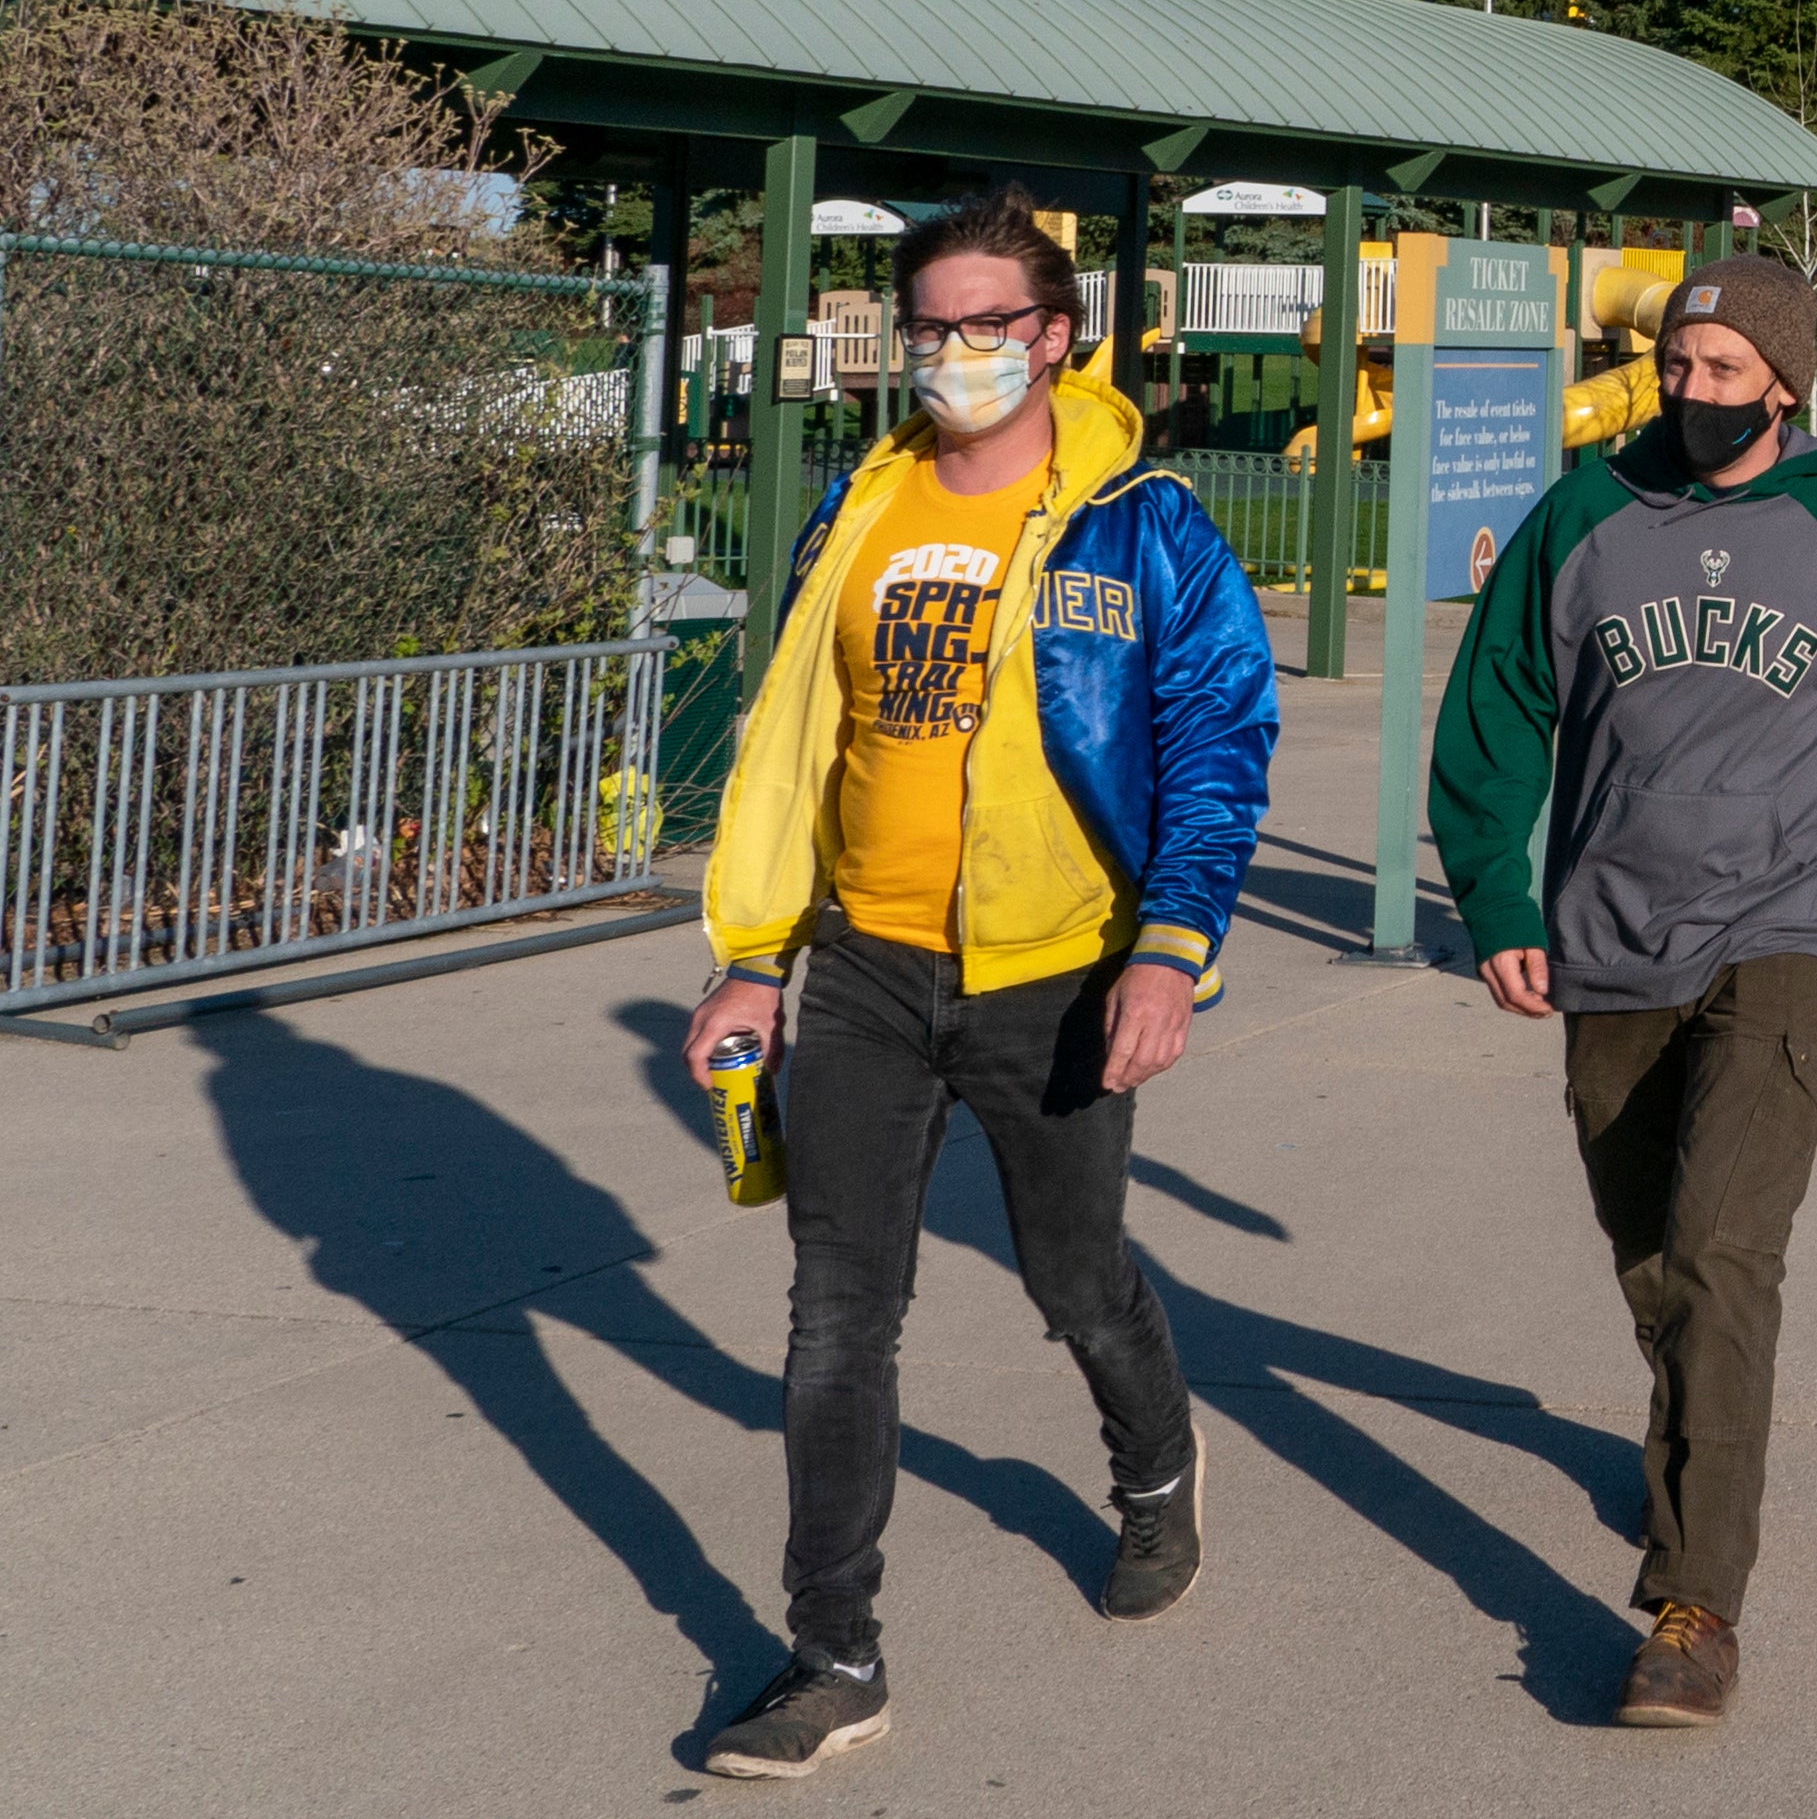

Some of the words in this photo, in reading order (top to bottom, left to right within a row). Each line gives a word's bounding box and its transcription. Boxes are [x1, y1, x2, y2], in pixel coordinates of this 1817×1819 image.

[1234, 201, 1274, 210] Children's
[1276, 202, 1303, 210] Health
[1235, 192, 1262, 201] Aurora
[816, 223, 854, 232] Children's
[856, 223, 884, 232] Health
[817, 214, 843, 222] Aurora
[1470, 257, 1530, 292] TICKET
[1445, 297, 1505, 332] RESALE
[1509, 300, 1549, 333] ZONE
[1435, 400, 1453, 419] The
[1454, 401, 1478, 418] resale
[1480, 399, 1490, 418] of
[1490, 402, 1511, 417] event
[1512, 399, 1536, 417] tickets
[1440, 428, 1453, 447] for
[1455, 427, 1473, 445] face
[1474, 428, 1497, 446] value,
[1499, 430, 1508, 444] or
[1509, 426, 1531, 443] below
[1432, 456, 1450, 475] face
[1452, 456, 1474, 473] value
[1475, 455, 1483, 471] is
[1483, 454, 1501, 476] only
[1502, 452, 1526, 470] lawful
[1526, 455, 1536, 468] on
[1431, 485, 1446, 503] the
[1447, 481, 1481, 501] sidewalk
[1483, 480, 1513, 498] between
[1514, 482, 1535, 500] signs.
[888, 543, 1000, 586] 2020
[879, 581, 982, 625] SPR
[873, 622, 972, 664] ING
[874, 662, 966, 693] TRAI
[877, 691, 958, 725] NING
[929, 722, 950, 739] AZ
[713, 1086, 728, 1116] TEA
[715, 1119, 744, 1187] TWISTED
